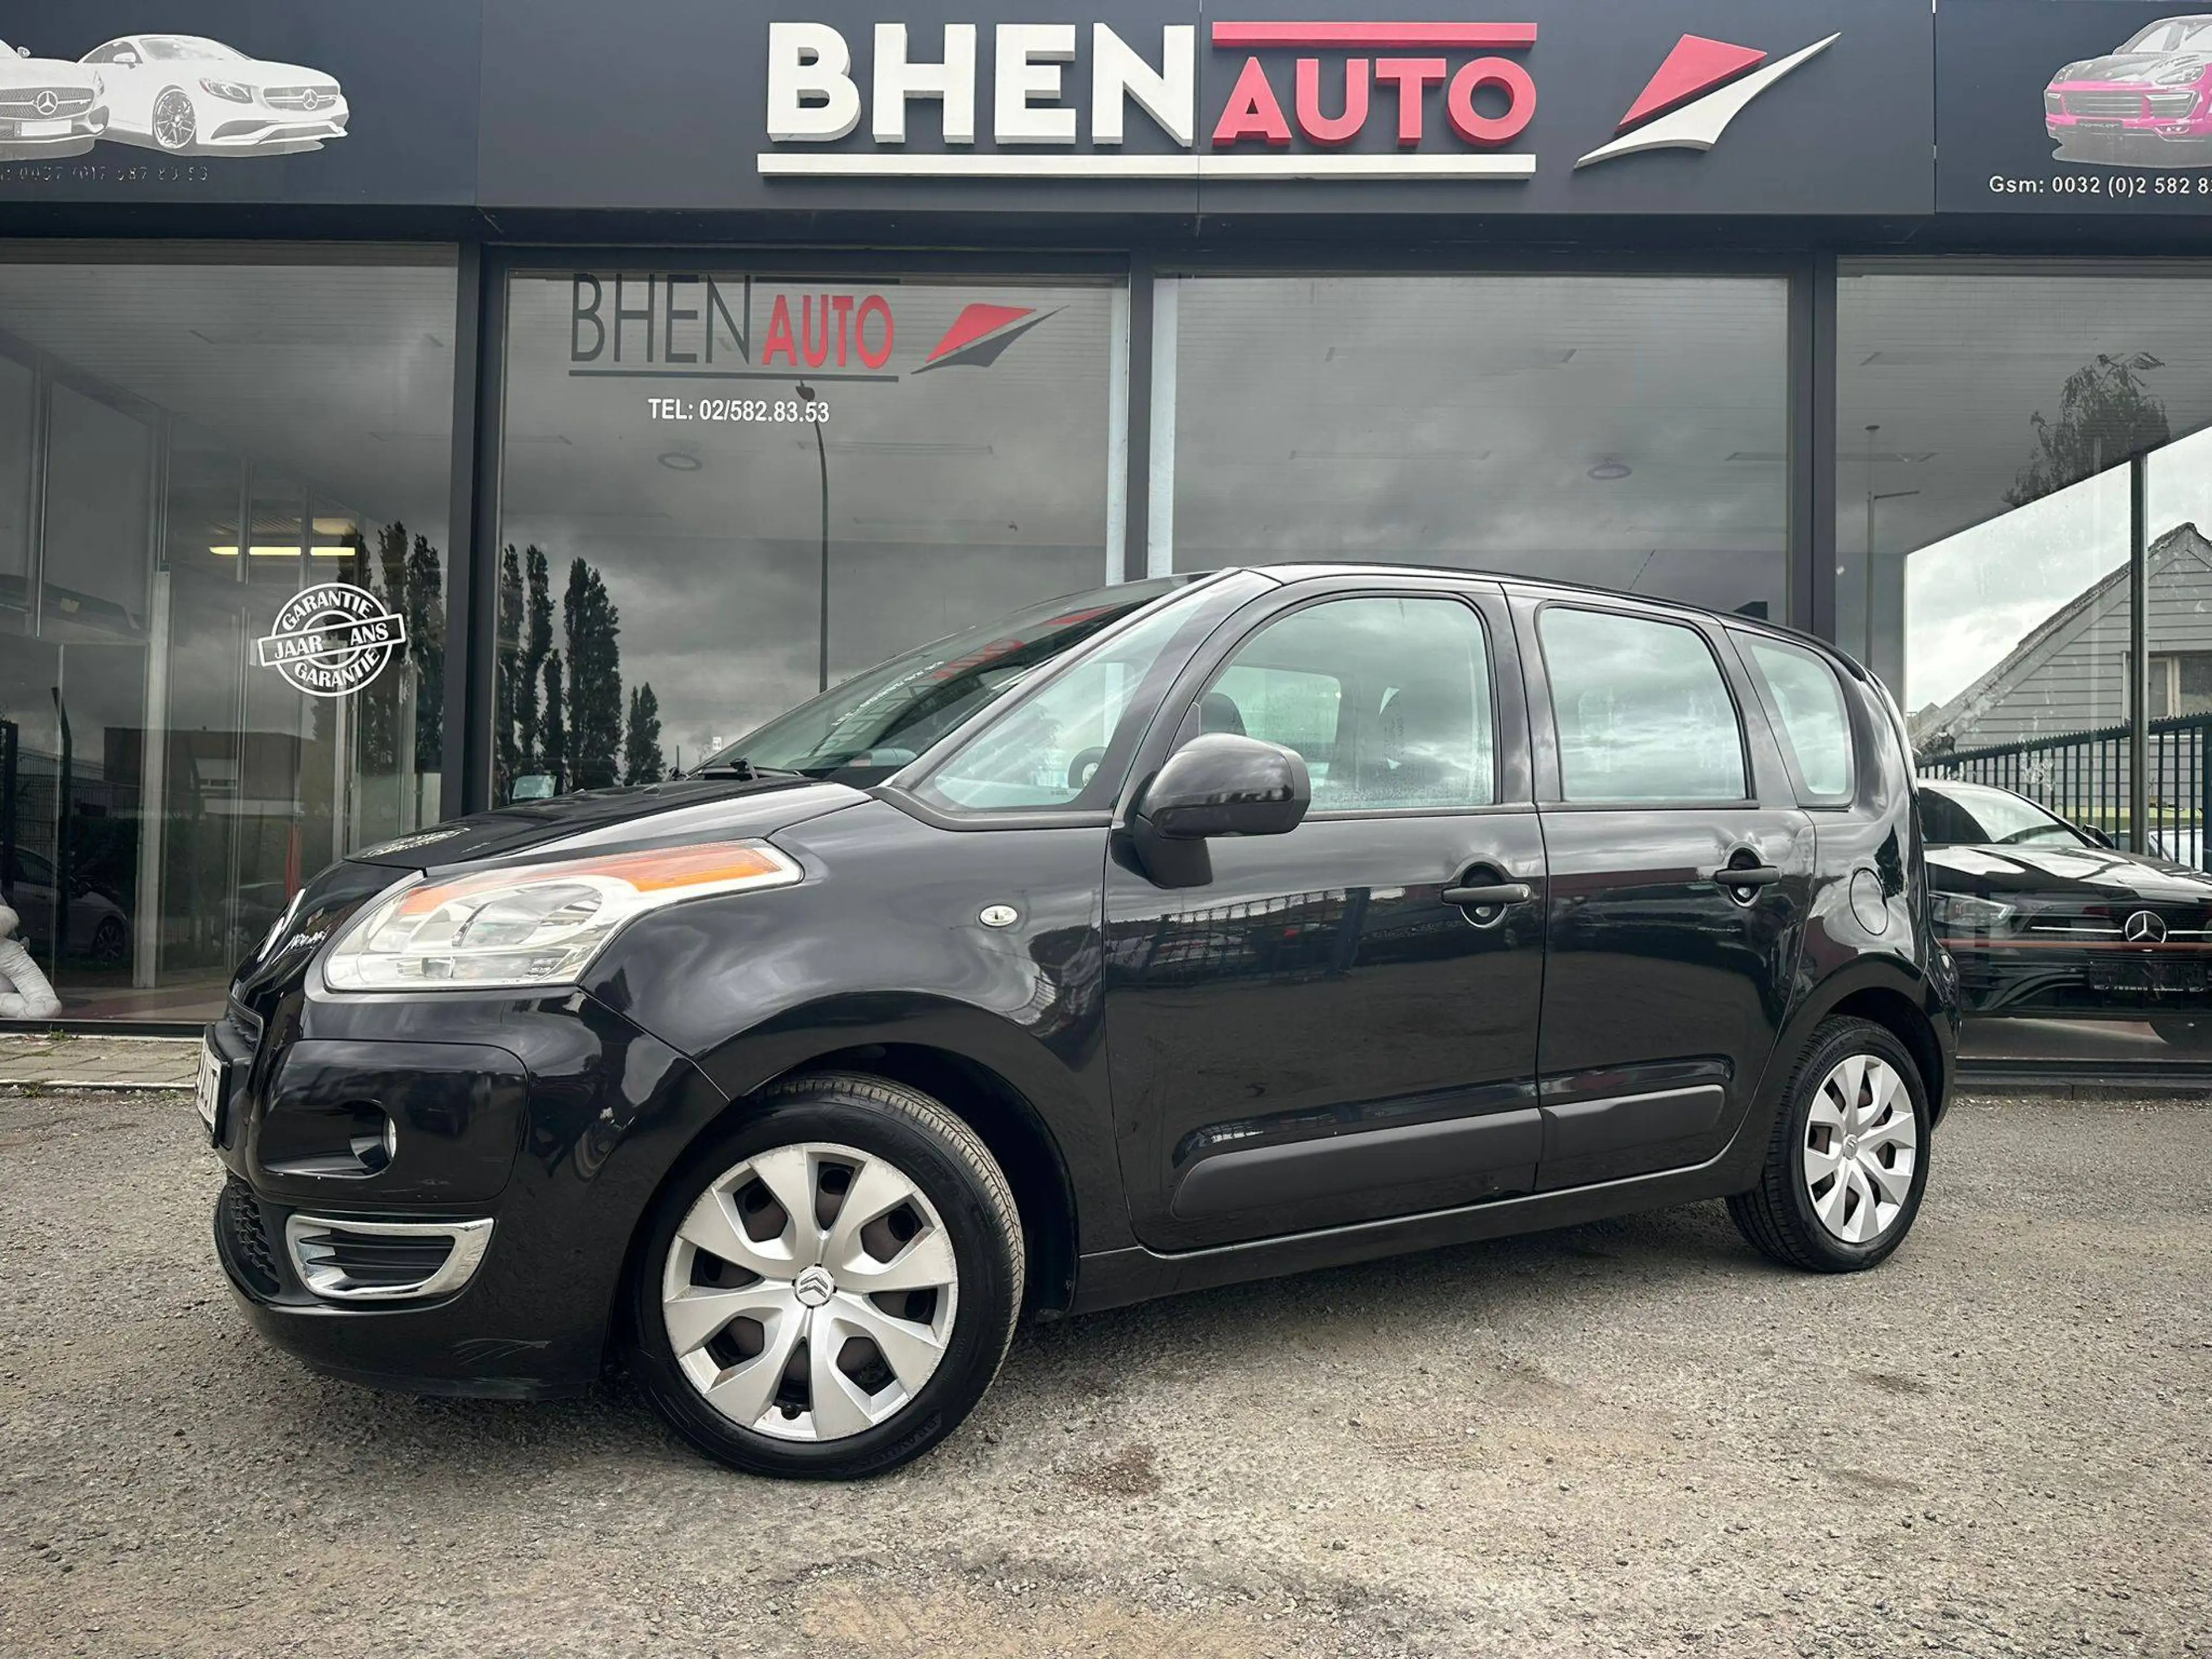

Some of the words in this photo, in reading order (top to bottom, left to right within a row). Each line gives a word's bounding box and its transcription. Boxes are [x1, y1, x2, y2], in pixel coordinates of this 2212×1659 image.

[767, 22, 1195, 147] BHEN
[1212, 56, 1537, 147] AUTO
[1989, 176, 2044, 193] Gsm:
[2052, 176, 2100, 193] 0032
[2108, 176, 2146, 198] (0)2
[2154, 177, 2190, 194] 582
[2198, 177, 2212, 194] 8
[571, 273, 751, 364] BHEN
[762, 294, 895, 370] AUTO
[648, 399, 694, 420] TEL:
[699, 399, 830, 423] 02/582.83.53
[282, 589, 374, 631] GARANTIE
[274, 635, 324, 660] JAAR
[350, 622, 389, 646] ANS
[294, 647, 380, 688] GARANTIE
